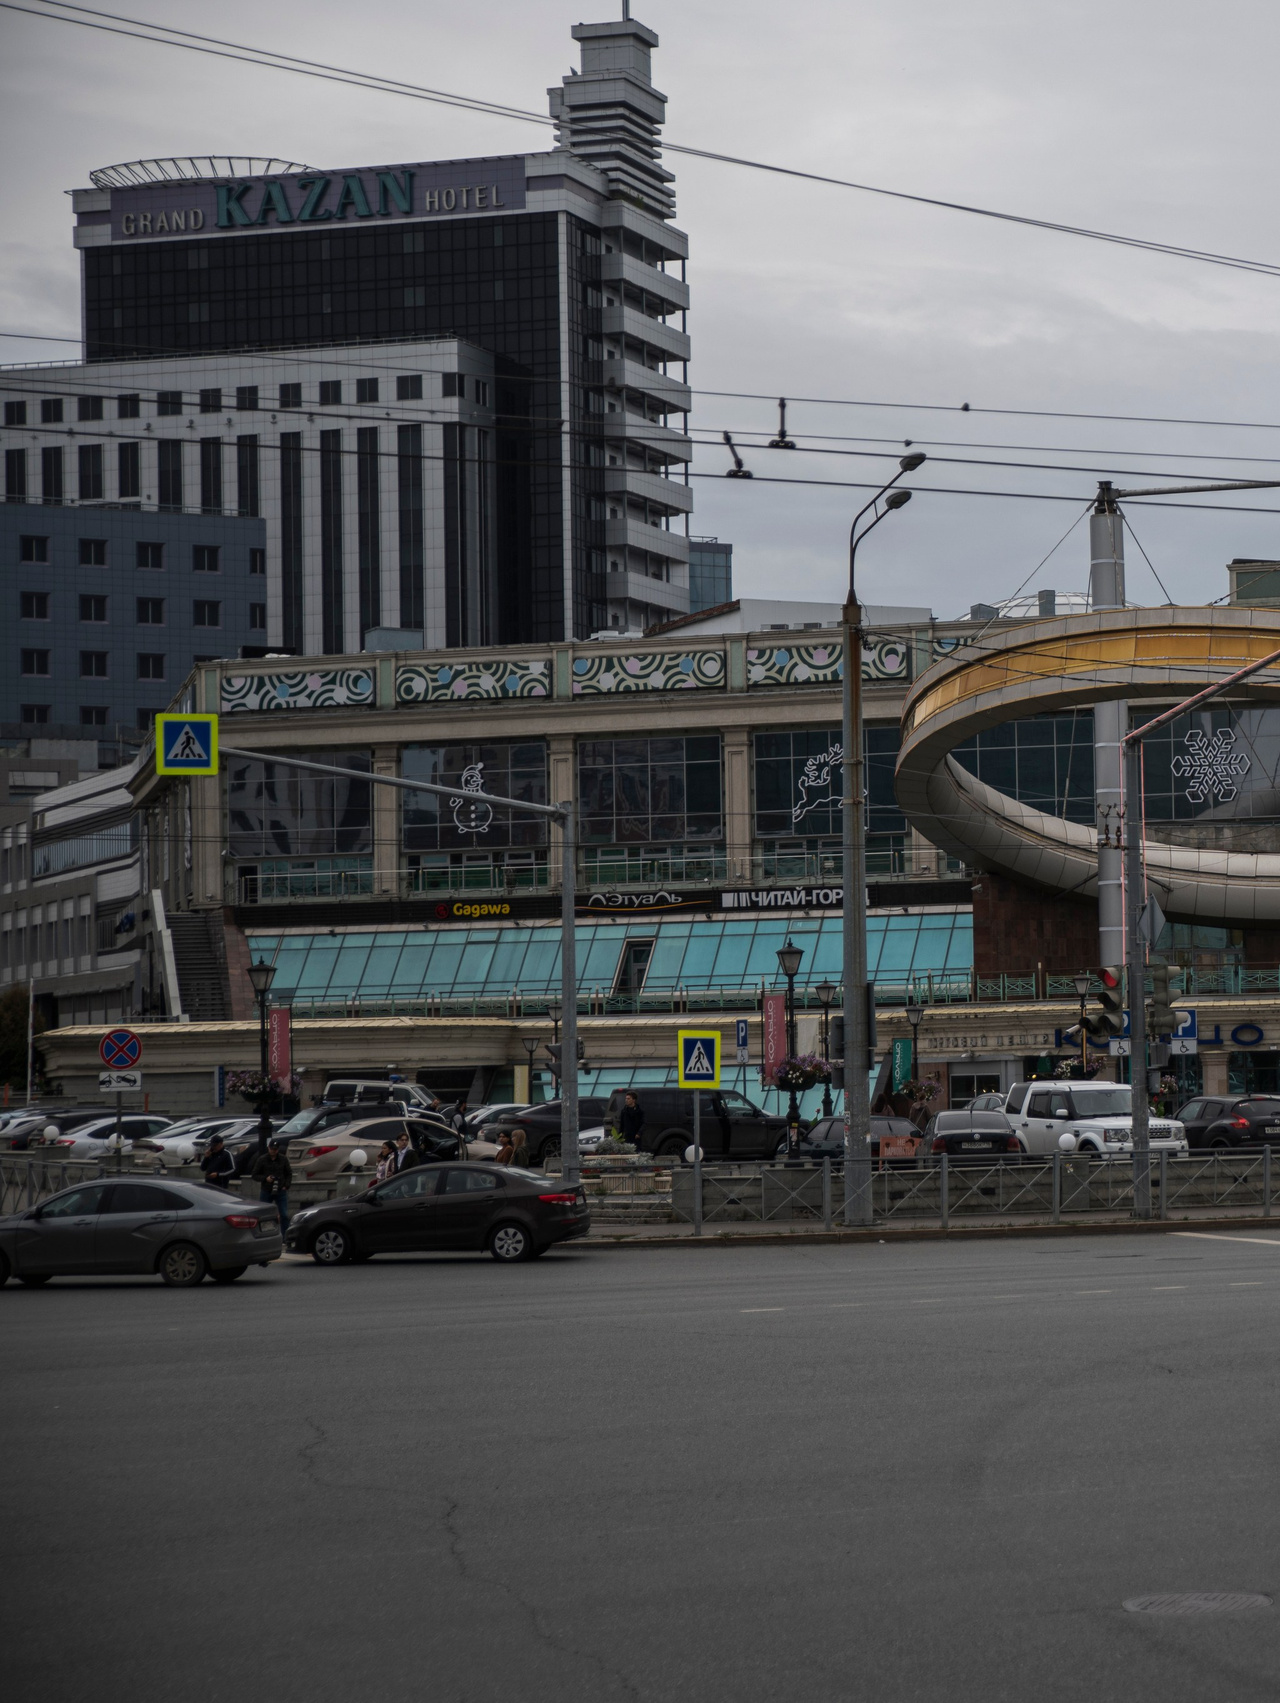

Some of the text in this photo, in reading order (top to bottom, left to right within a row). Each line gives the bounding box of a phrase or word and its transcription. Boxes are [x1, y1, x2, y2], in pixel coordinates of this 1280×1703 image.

[121, 169, 504, 236] GRAND KAZAN HOTEL
[750, 886, 871, 908] ЧИТАЙ-ГОР
[452, 902, 511, 919] Gagawa
